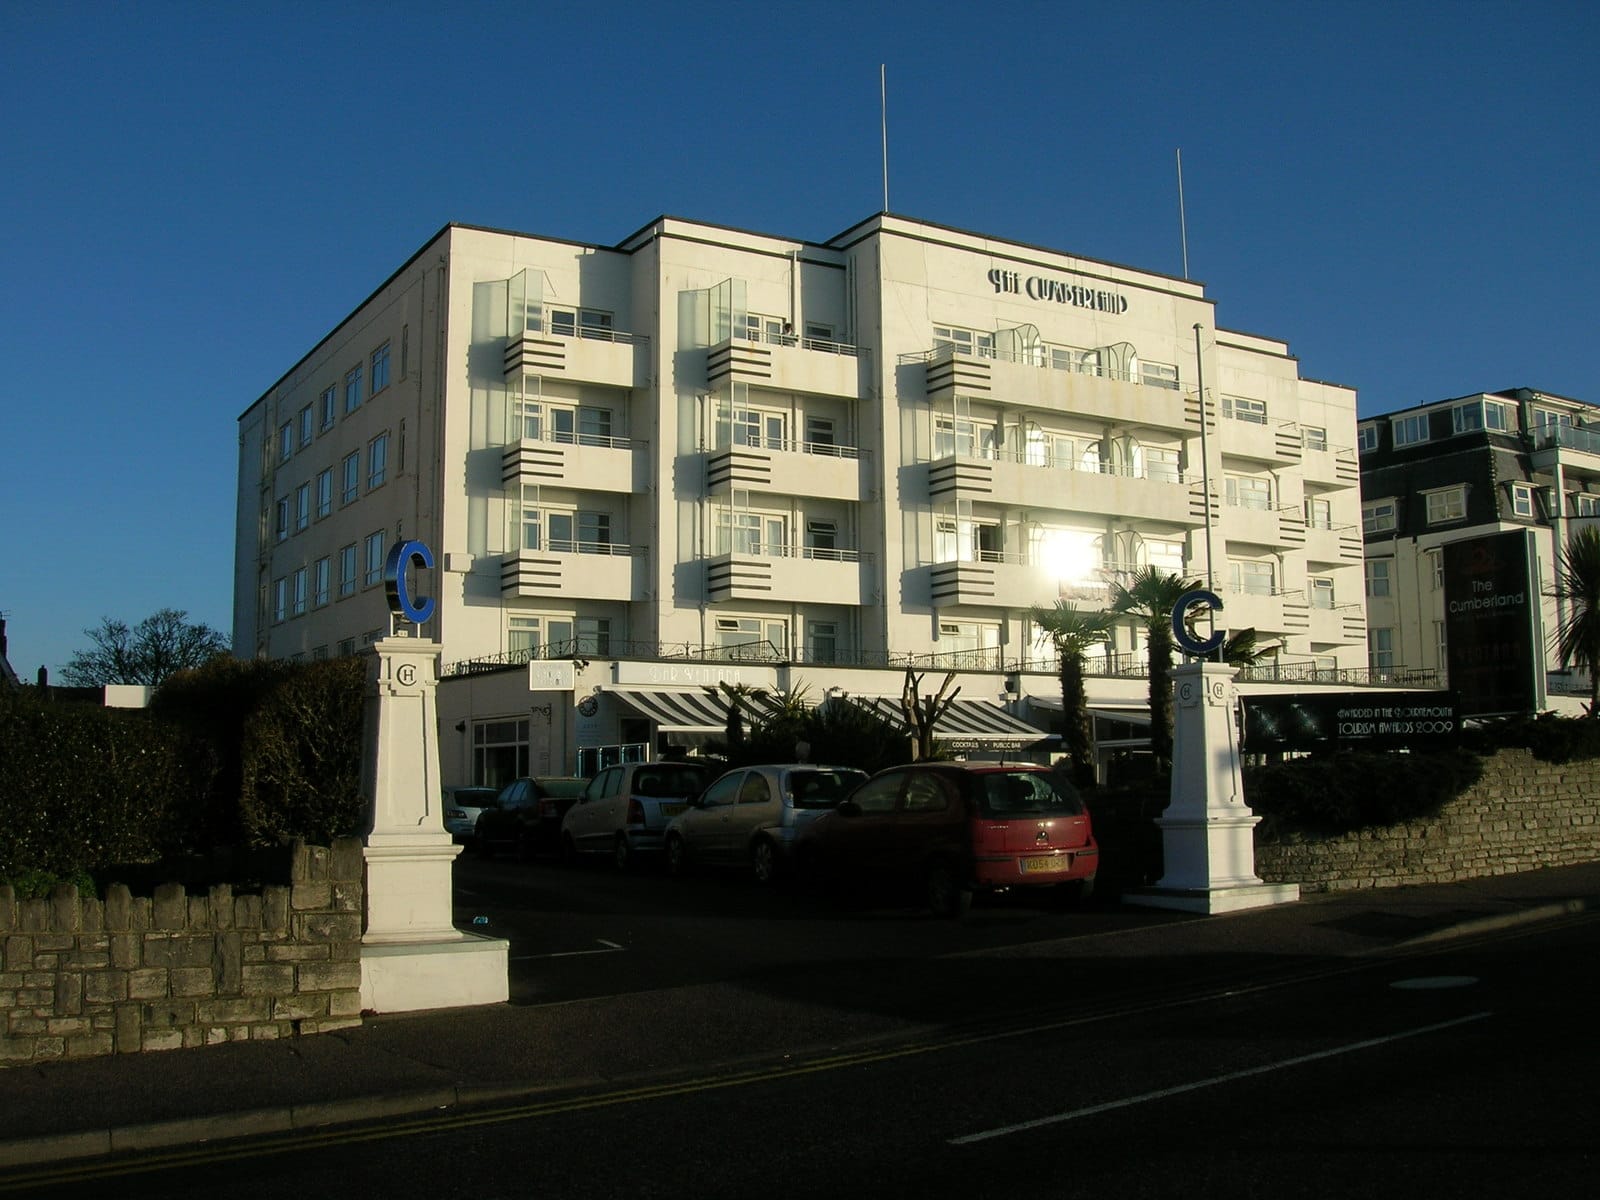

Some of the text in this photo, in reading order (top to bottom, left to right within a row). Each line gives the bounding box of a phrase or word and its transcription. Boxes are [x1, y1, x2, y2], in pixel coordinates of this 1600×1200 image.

[1025, 276, 1128, 315] CUMBERLAND
[1472, 580, 1493, 592] The
[1449, 592, 1524, 613] Cumberland
[1172, 590, 1226, 654] C
[1337, 708, 1373, 719] AWARDED
[1382, 707, 1393, 718] THE
[1394, 707, 1453, 718] BOURNEMOUTH
[1337, 721, 1453, 735] TOURISM AWARDS 2009
[951, 741, 979, 749] COCKTAILS
[992, 741, 1011, 749] PUBLIC
